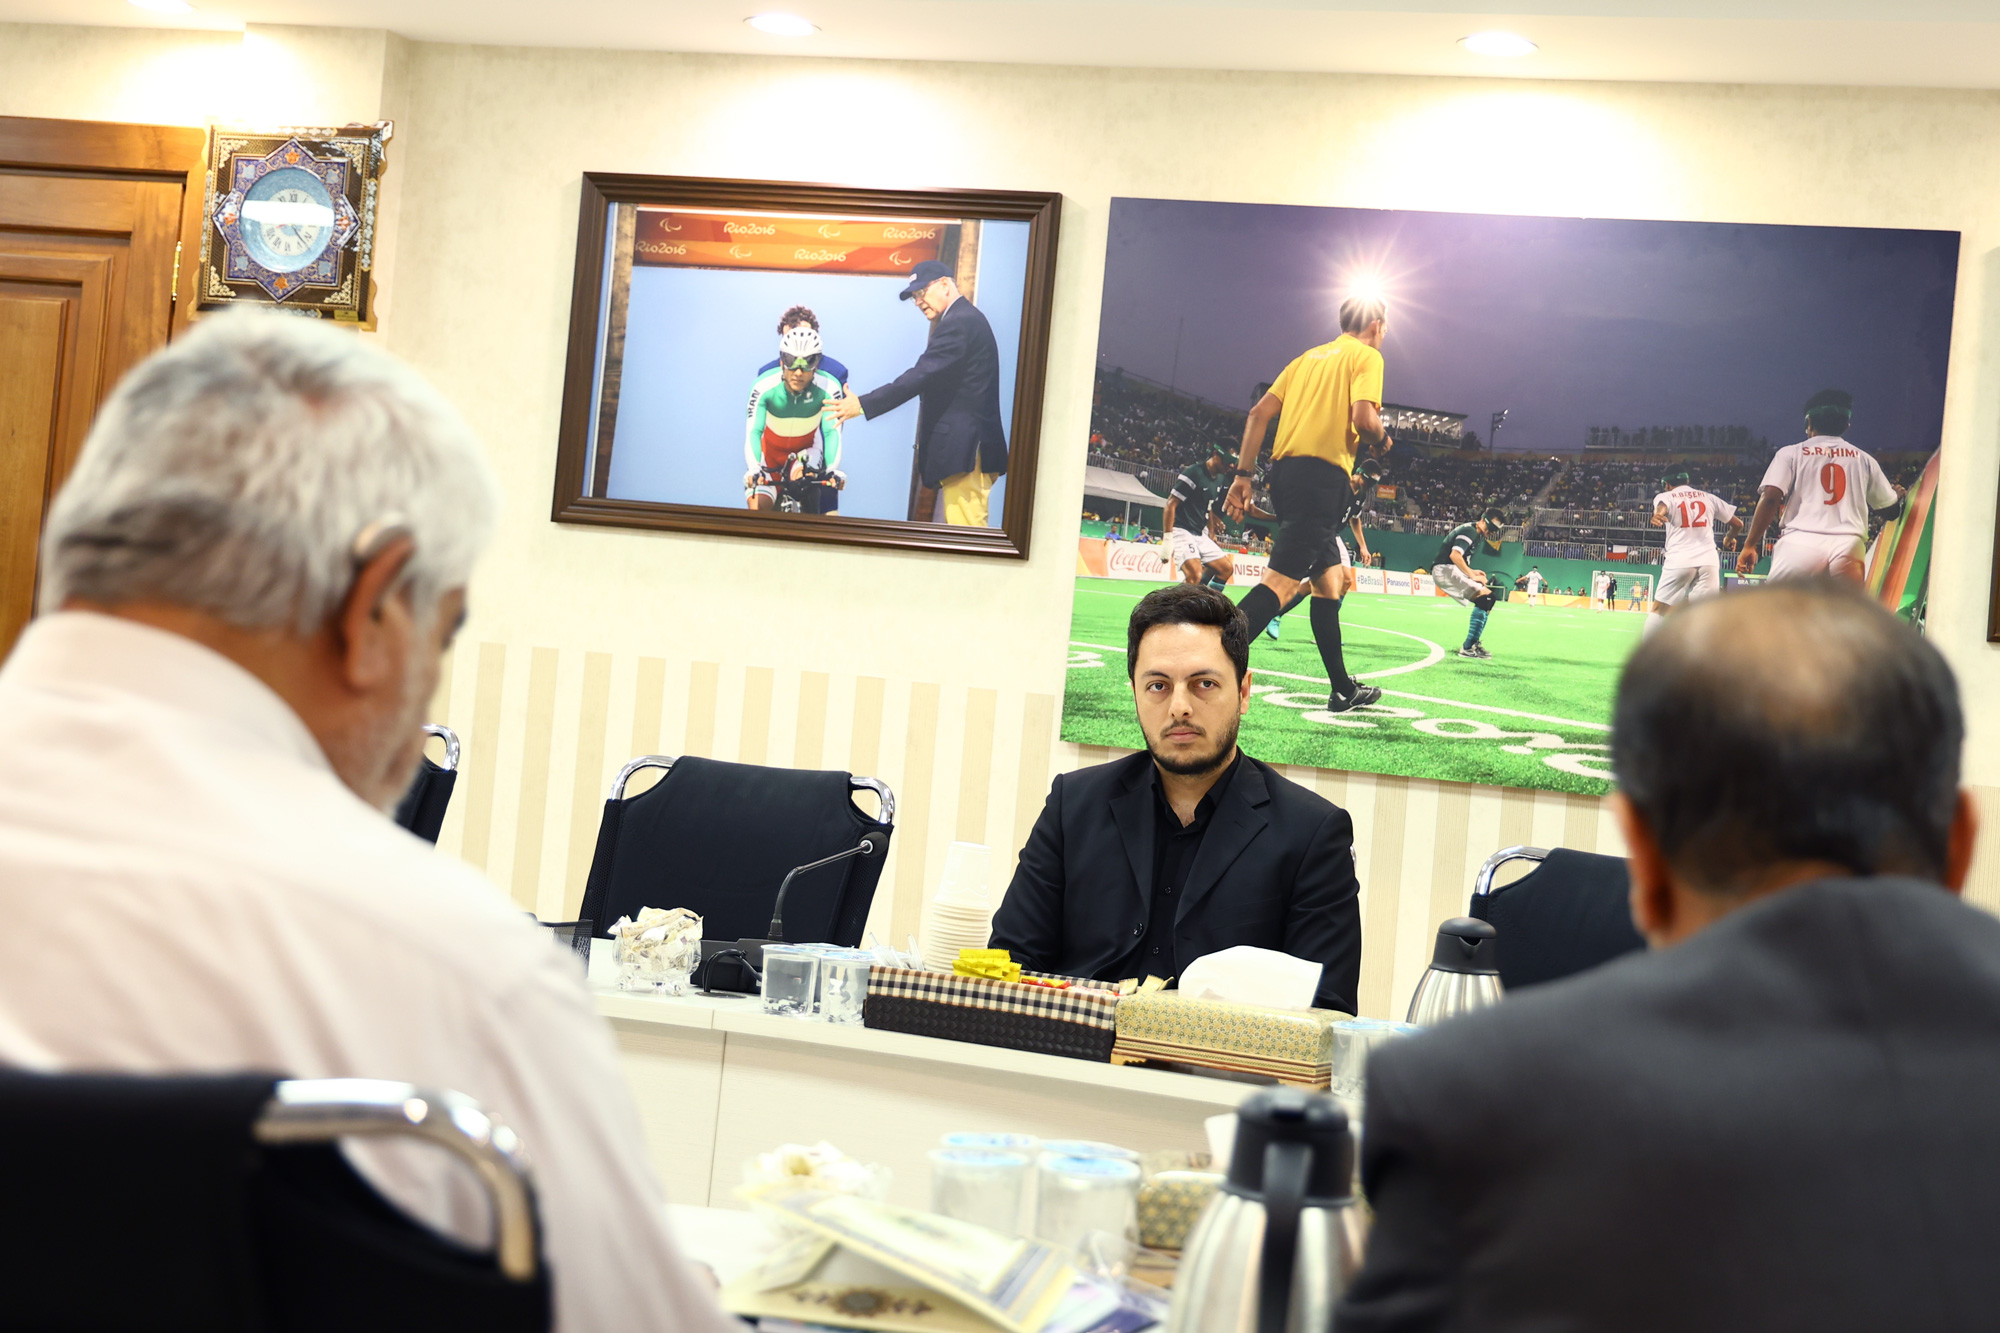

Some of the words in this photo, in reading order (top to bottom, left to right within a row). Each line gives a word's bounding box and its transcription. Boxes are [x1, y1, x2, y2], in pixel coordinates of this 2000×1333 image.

[724, 222, 776, 235] Rio2016
[883, 227, 936, 239] Rio2016
[635, 240, 687, 255] Rio2016
[794, 249, 847, 262] Rio2016
[1820, 463, 1846, 505] 9
[1677, 501, 1707, 528] 12
[1188, 543, 1196, 553] 5
[1387, 578, 1410, 587] Panasonic
